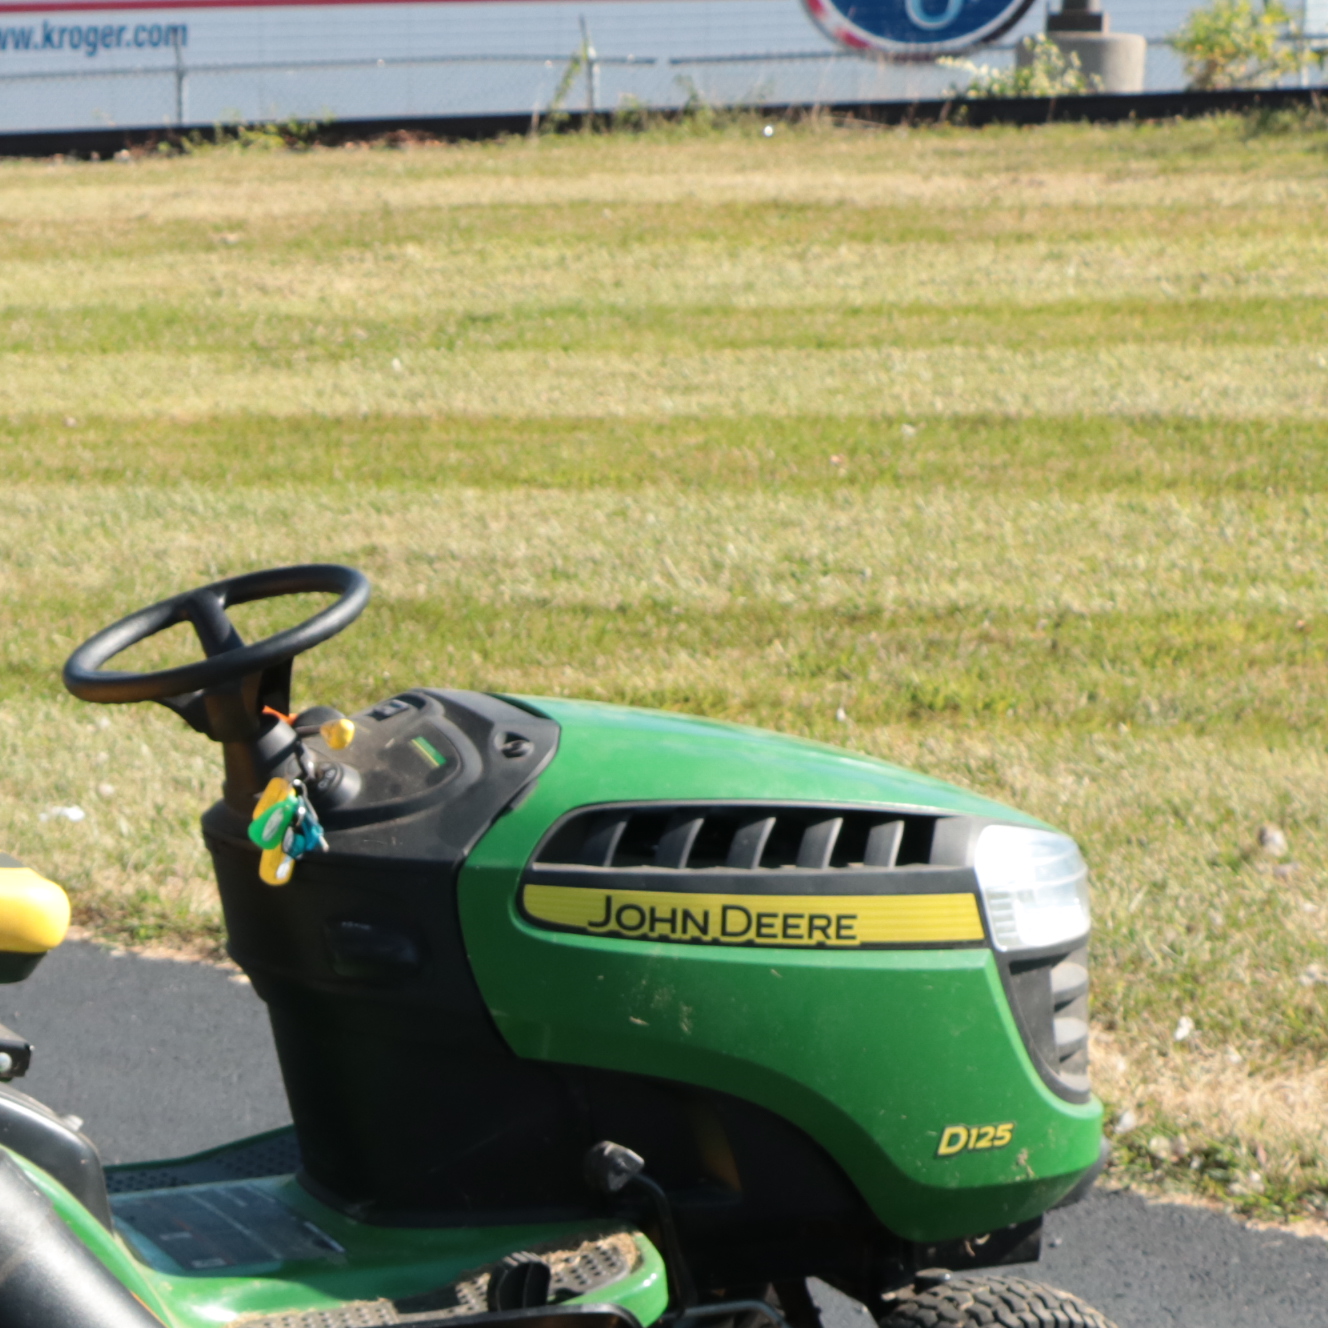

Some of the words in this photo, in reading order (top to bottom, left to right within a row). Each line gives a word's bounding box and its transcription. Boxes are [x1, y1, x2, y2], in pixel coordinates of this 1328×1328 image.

[587, 895, 709, 936] JOHN
[721, 904, 858, 940] DEERE
[937, 1122, 1015, 1156] D125
